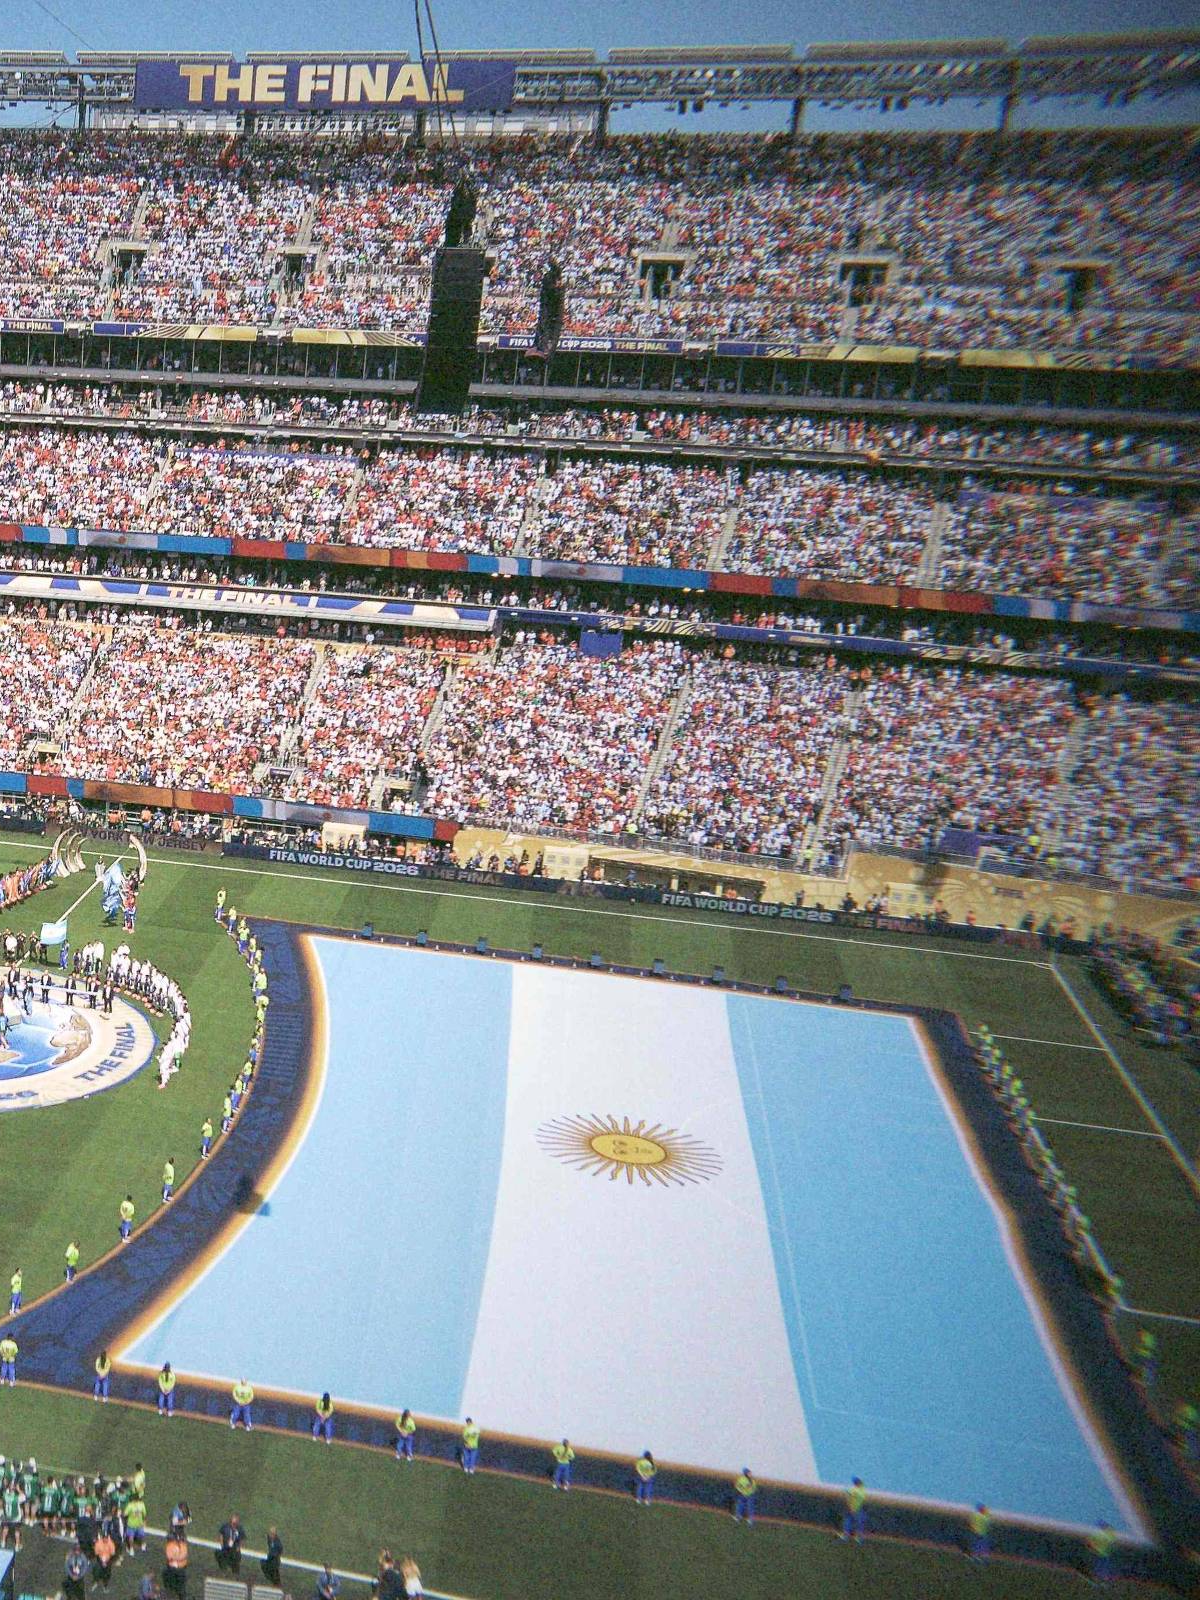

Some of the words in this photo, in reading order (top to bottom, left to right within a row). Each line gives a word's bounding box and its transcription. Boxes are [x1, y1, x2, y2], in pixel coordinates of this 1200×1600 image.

[180, 64, 288, 102] THE
[298, 64, 465, 102] FINAL
[7, 321, 26, 330] THE
[27, 322, 53, 331] FINAL
[509, 338, 527, 347] FIFA
[561, 340, 580, 349] CUP
[580, 340, 612, 350] 2026
[615, 341, 636, 350] THE
[637, 342, 669, 351] FINAL
[167, 586, 218, 601] THE
[220, 590, 298, 607] FINAL
[270, 849, 296, 863] FIFA
[298, 852, 344, 868] WORLD
[345, 857, 371, 871] CUP
[373, 861, 419, 876] 2026
[661, 893, 692, 908] FIFA
[695, 897, 747, 914] WORLD
[748, 903, 779, 917] CUP
[780, 907, 833, 923] 2026
[72, 1059, 122, 1081] THE
[109, 1021, 136, 1059] FINAL
